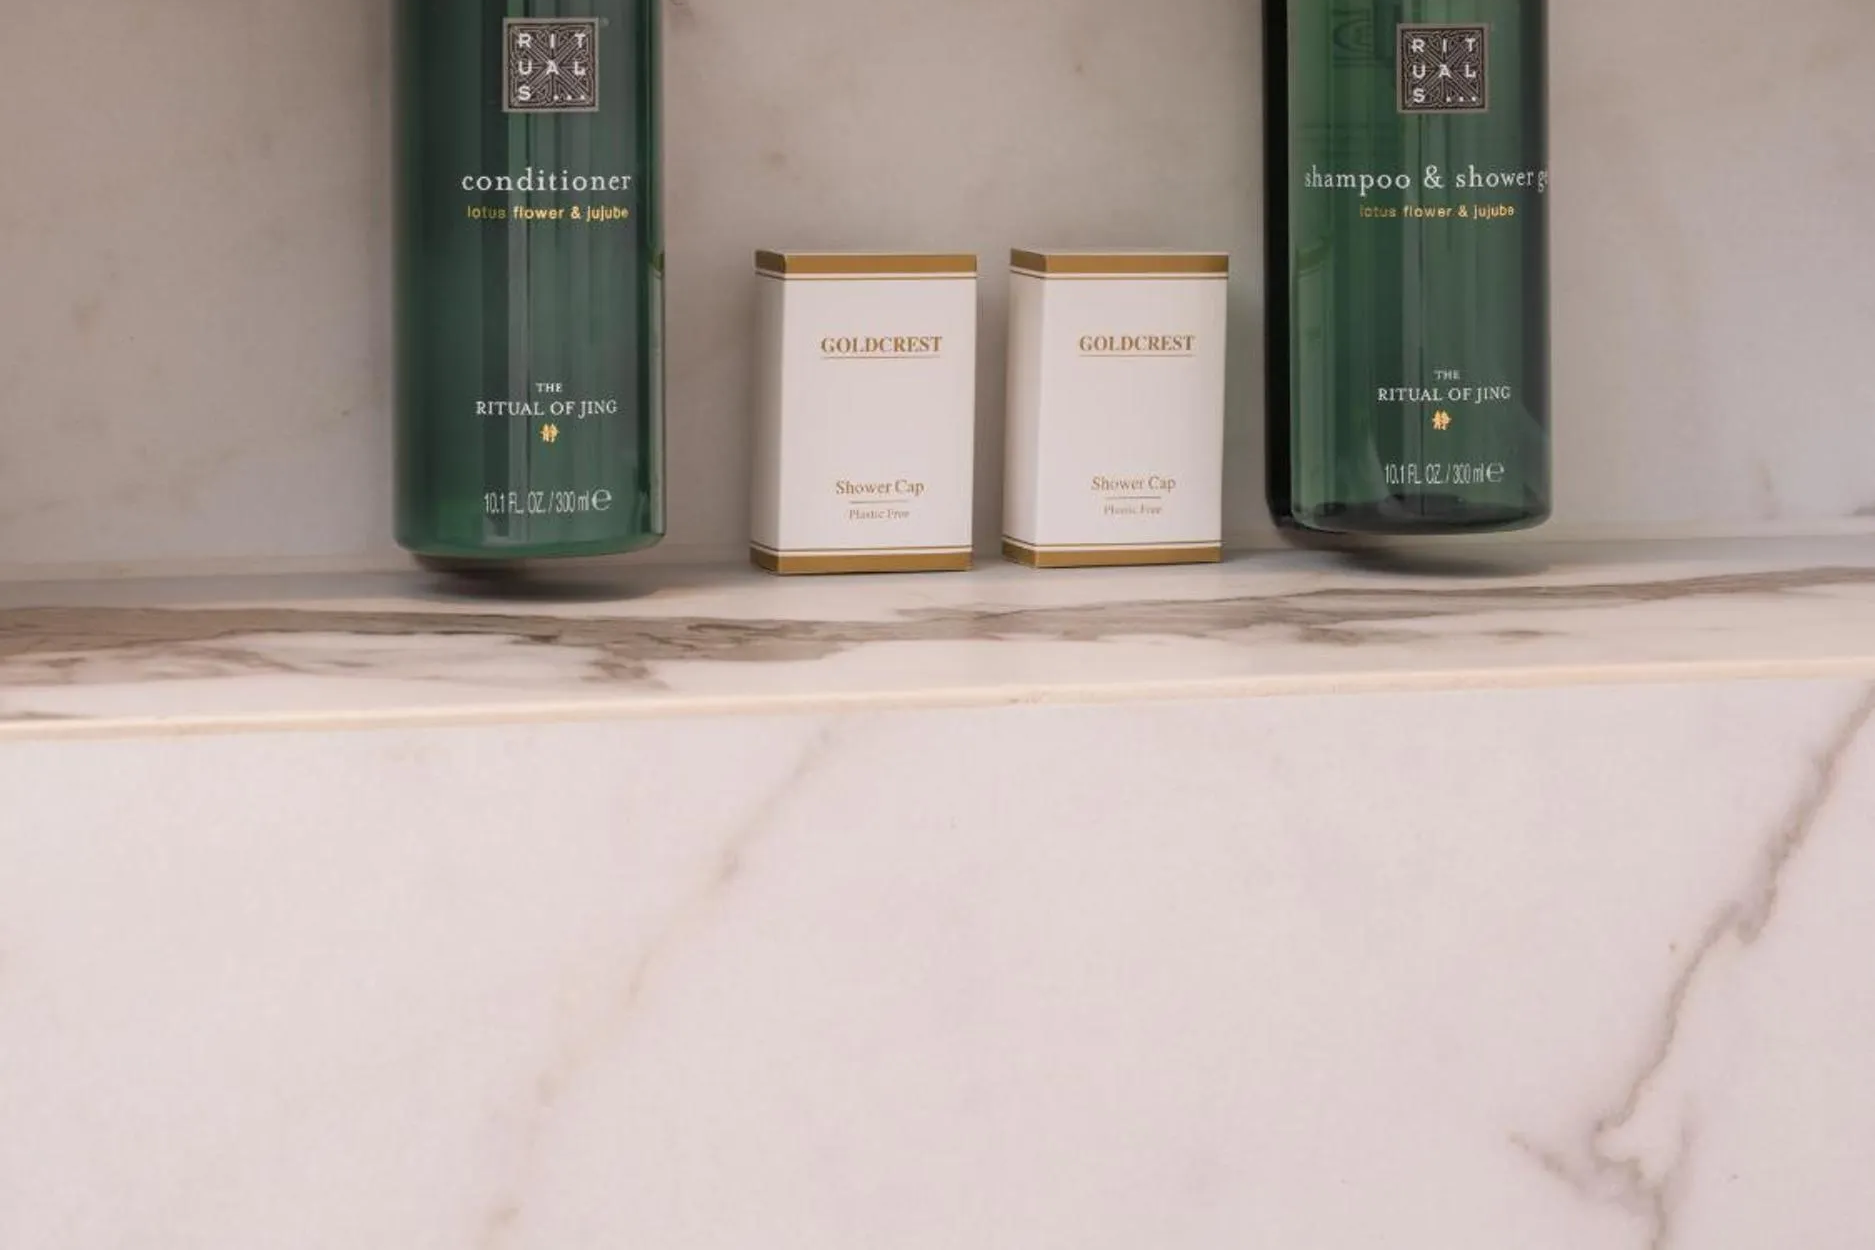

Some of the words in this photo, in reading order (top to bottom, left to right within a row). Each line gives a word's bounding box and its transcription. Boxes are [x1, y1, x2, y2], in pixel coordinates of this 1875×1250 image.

[461, 166, 632, 191] conditioner
[1304, 164, 1411, 197] shampoo
[1424, 164, 1445, 189] &
[1456, 164, 1534, 188] shower
[467, 205, 507, 220] lotus
[514, 205, 565, 220] flower
[570, 205, 582, 220] &
[586, 205, 630, 222] jujube
[1359, 205, 1397, 218] lotus
[1404, 204, 1452, 218] flower
[1458, 204, 1468, 218] &
[1472, 204, 1515, 220] jujube
[821, 336, 944, 353] GOLDCREST
[1079, 334, 1195, 352] GOLDCREST
[1434, 369, 1460, 380] THE
[536, 382, 563, 393] THE
[1378, 387, 1443, 402] RITUAL
[1447, 387, 1472, 402] OF
[1474, 385, 1512, 404] JING
[475, 400, 545, 416] RITUAL
[550, 400, 576, 416] OF
[577, 399, 617, 419] JING
[1385, 463, 1406, 485] 10.1
[835, 479, 892, 495] Shower
[894, 478, 925, 497] Cap
[1091, 475, 1144, 491] Shower
[1147, 475, 1177, 495] Cap
[484, 491, 505, 515] 10.1
